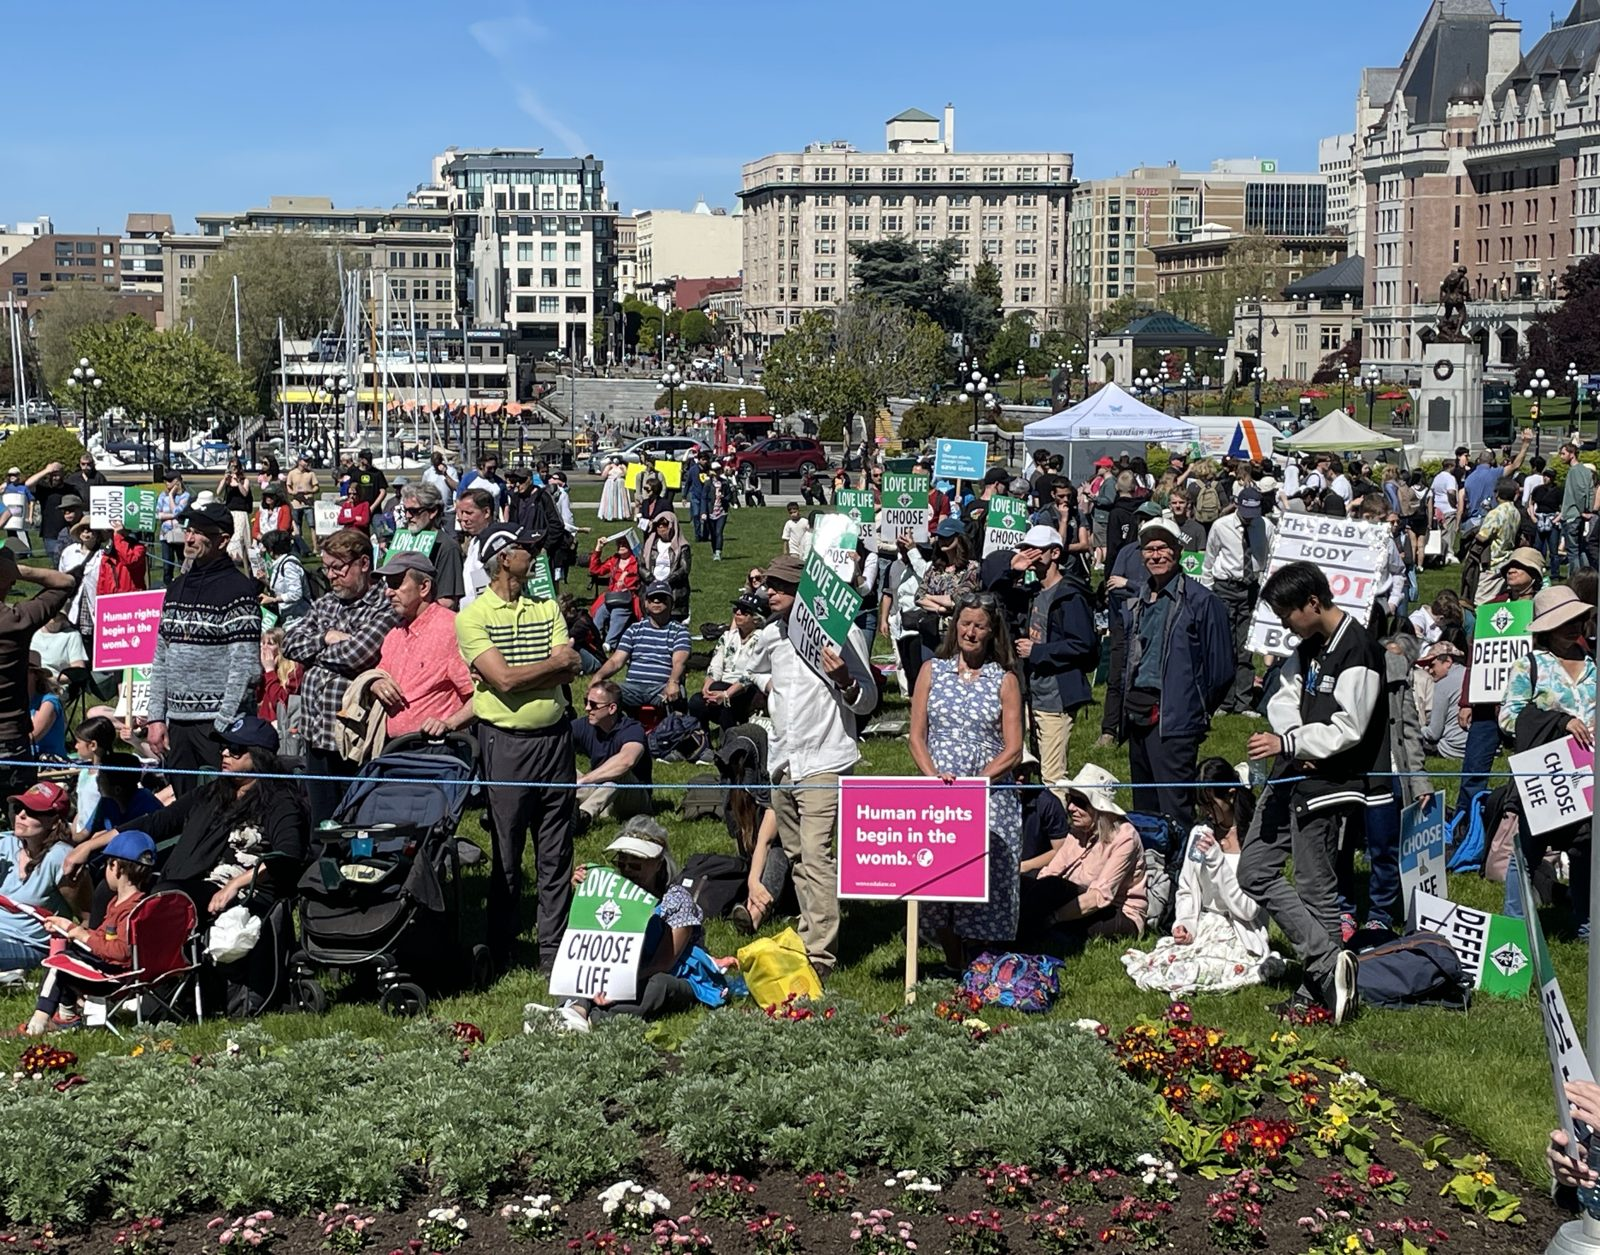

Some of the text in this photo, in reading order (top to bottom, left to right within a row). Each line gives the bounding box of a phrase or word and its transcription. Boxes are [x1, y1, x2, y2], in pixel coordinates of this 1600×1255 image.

[1263, 162, 1274, 171] TD
[884, 476, 928, 493] LOVE LIFE
[92, 498, 107, 516] LIFE
[838, 491, 873, 508] LOVE LIFE
[991, 497, 1026, 517] LOVE LIFE
[139, 490, 155, 531] LOVE LIFE
[886, 509, 924, 525] CHOOSE
[391, 532, 435, 552] LOVE LIFE
[1299, 544, 1353, 562] BODY
[806, 551, 859, 621] LOVE LIFE
[1328, 574, 1372, 599] OT
[102, 608, 161, 622] Human rights
[102, 622, 152, 637] begin in the
[102, 639, 129, 650] womb.
[799, 637, 821, 670] LIFE
[1524, 774, 1548, 808] LIFE
[1543, 752, 1577, 816] CHOOSE
[856, 804, 973, 824] Human rights
[856, 826, 957, 847] begin in the
[1402, 823, 1442, 857] CHOOSE
[855, 850, 912, 866] womb.
[578, 867, 621, 898] LOVE
[567, 933, 635, 964] CHOOSE
[576, 965, 611, 997] LIFE
